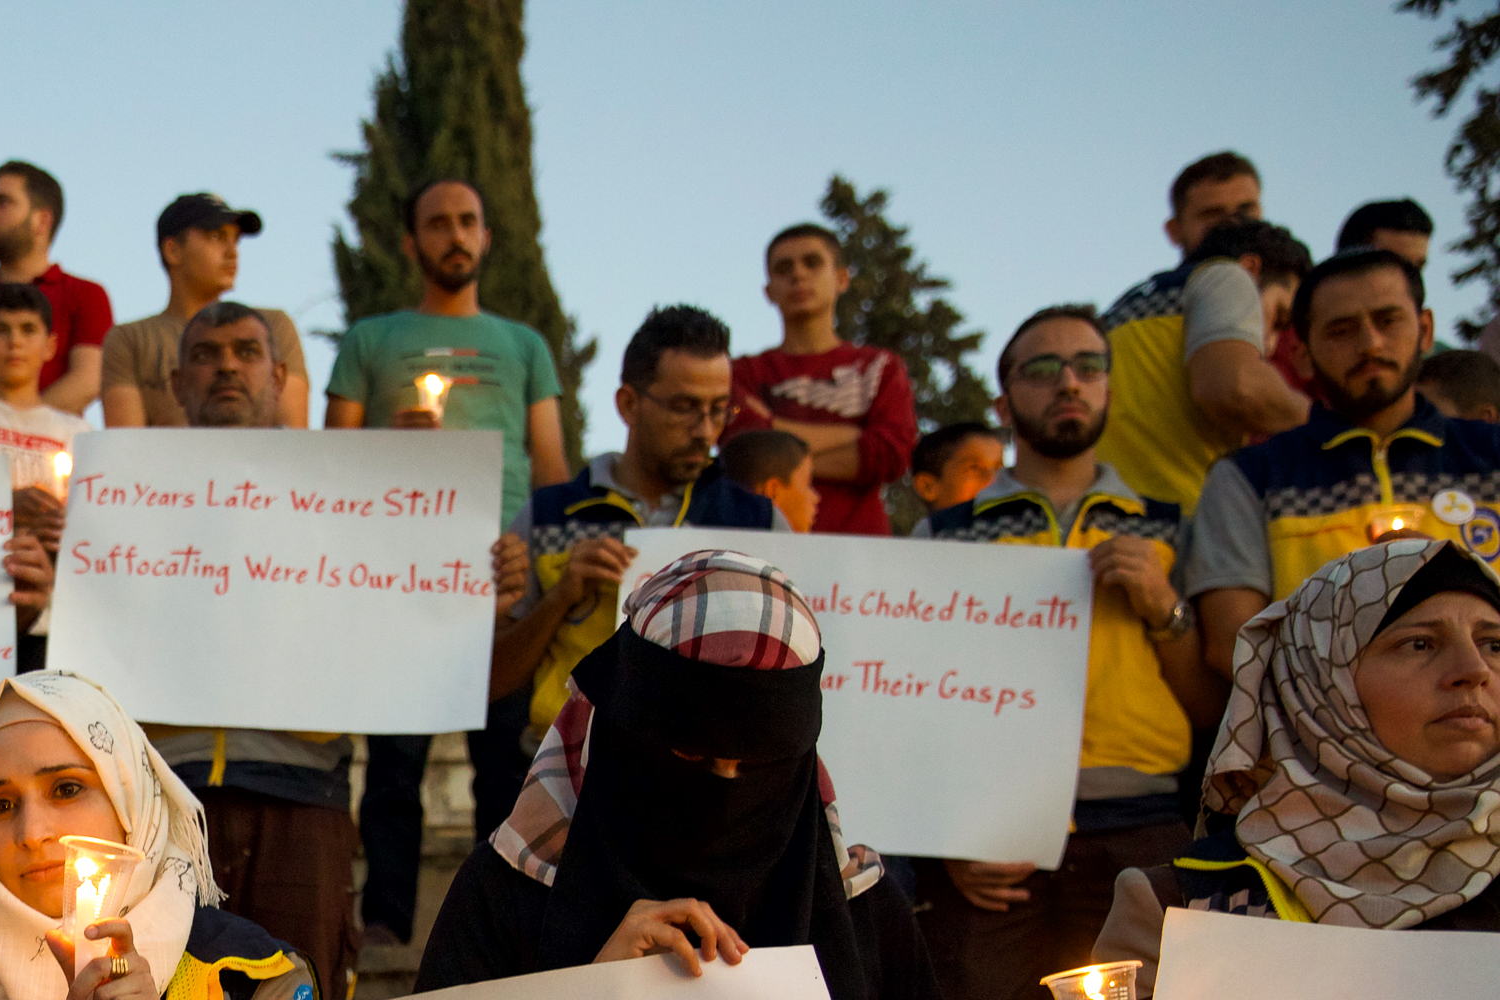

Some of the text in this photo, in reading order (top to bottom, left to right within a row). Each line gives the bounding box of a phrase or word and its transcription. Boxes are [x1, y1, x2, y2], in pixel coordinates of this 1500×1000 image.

[76, 473, 127, 505] Ten
[132, 482, 195, 508] Years
[206, 479, 276, 510] Later
[384, 488, 456, 516] Still
[72, 541, 490, 596] Suffocating Were Is Our Justice
[859, 590, 958, 622] Choked
[995, 596, 1077, 629] death
[852, 660, 930, 697] Their
[939, 670, 1035, 716] Gasps
